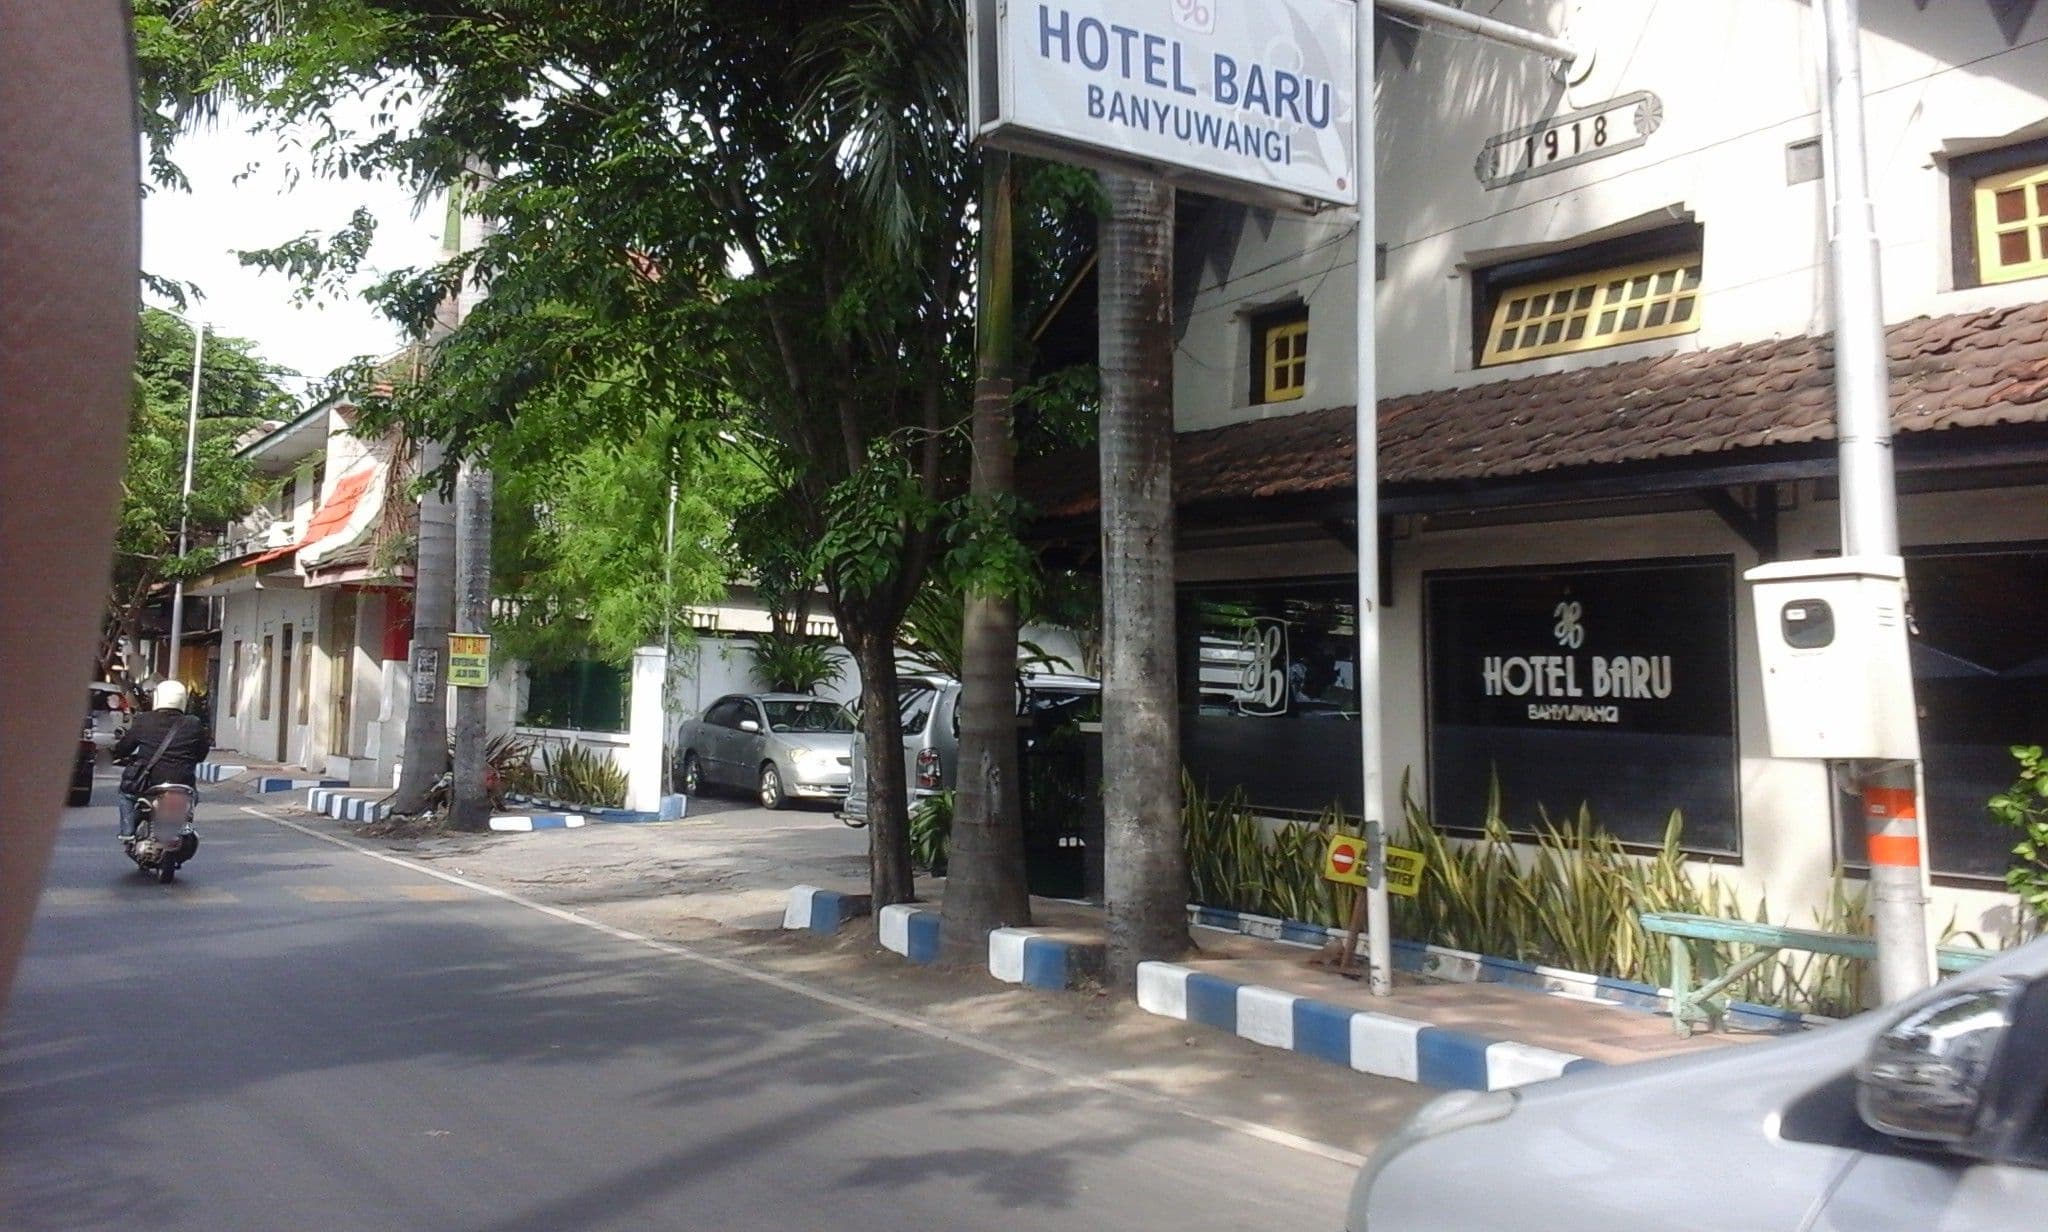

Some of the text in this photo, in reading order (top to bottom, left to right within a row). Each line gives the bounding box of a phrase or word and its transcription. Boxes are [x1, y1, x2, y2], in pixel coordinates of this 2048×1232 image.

[1038, 4, 1331, 130] HOTEL BARU
[1087, 84, 1291, 166] BANYUWANGI
[1525, 115, 1607, 168] 1918
[1483, 655, 1673, 699] HOTEL BARU
